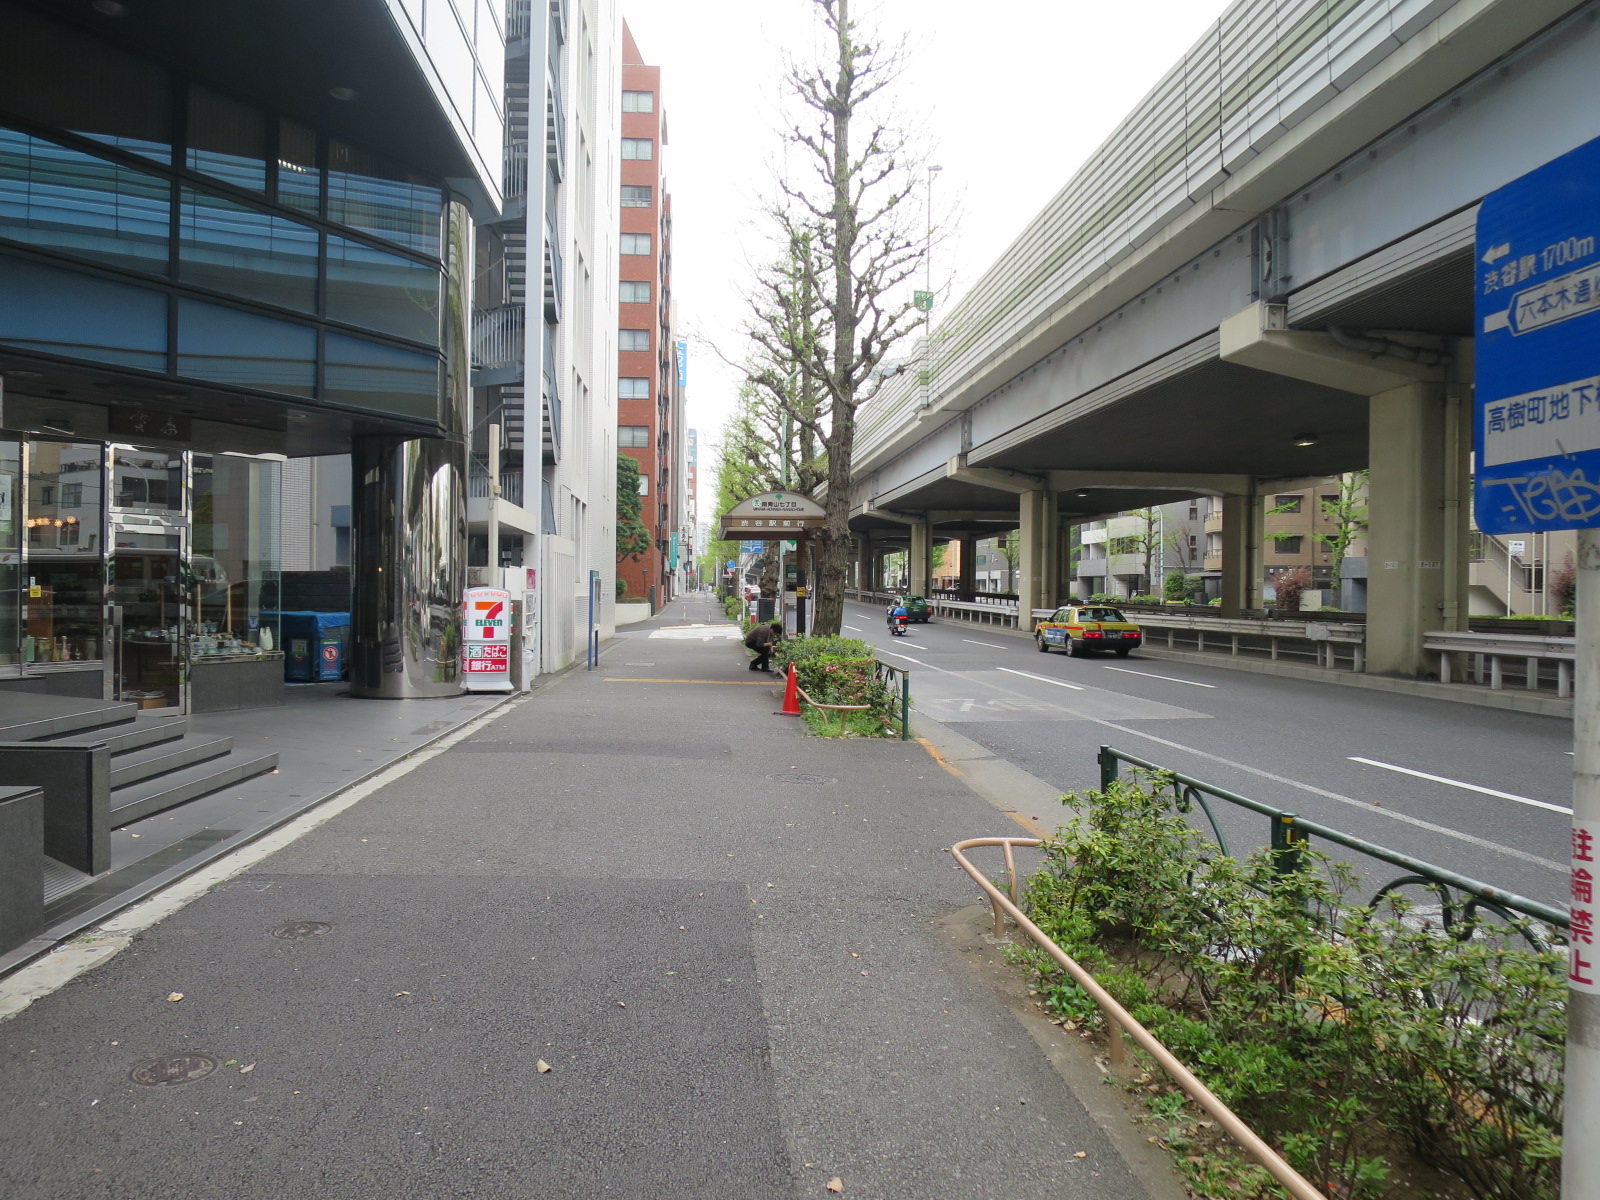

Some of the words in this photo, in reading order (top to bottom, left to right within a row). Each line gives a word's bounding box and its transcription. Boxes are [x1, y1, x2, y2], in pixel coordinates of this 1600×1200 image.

[1484, 253, 1536, 295] 渋谷駅
[1540, 236, 1594, 271] 1700m
[1488, 384, 1600, 434] 高樹町地下
[741, 519, 804, 527] 渋谷駅前行
[470, 645, 482, 658] 酒
[483, 646, 507, 658] たばこ
